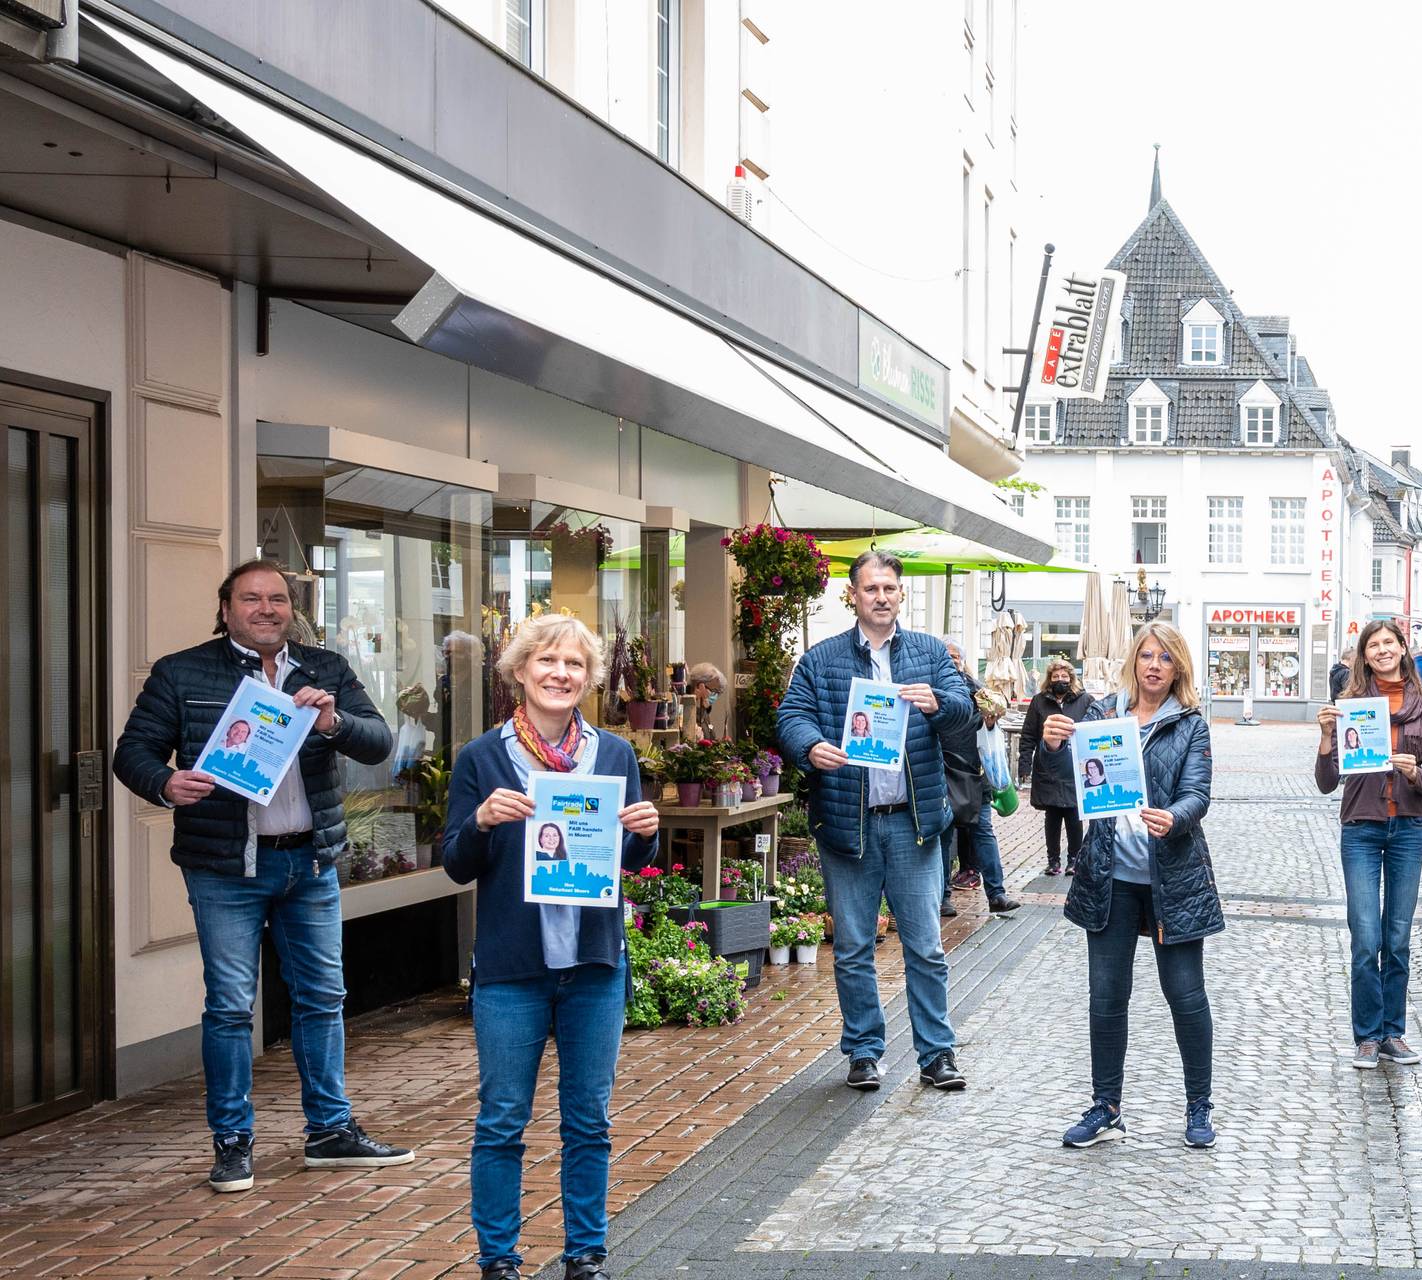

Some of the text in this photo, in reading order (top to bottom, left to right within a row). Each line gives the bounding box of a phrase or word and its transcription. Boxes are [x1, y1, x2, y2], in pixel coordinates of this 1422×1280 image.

[1056, 271, 1097, 389] extrablatt
[1321, 468, 1334, 621] APOTHEKE
[1211, 609, 1296, 623] APOTHEKE
[552, 800, 583, 808] Fairtrade
